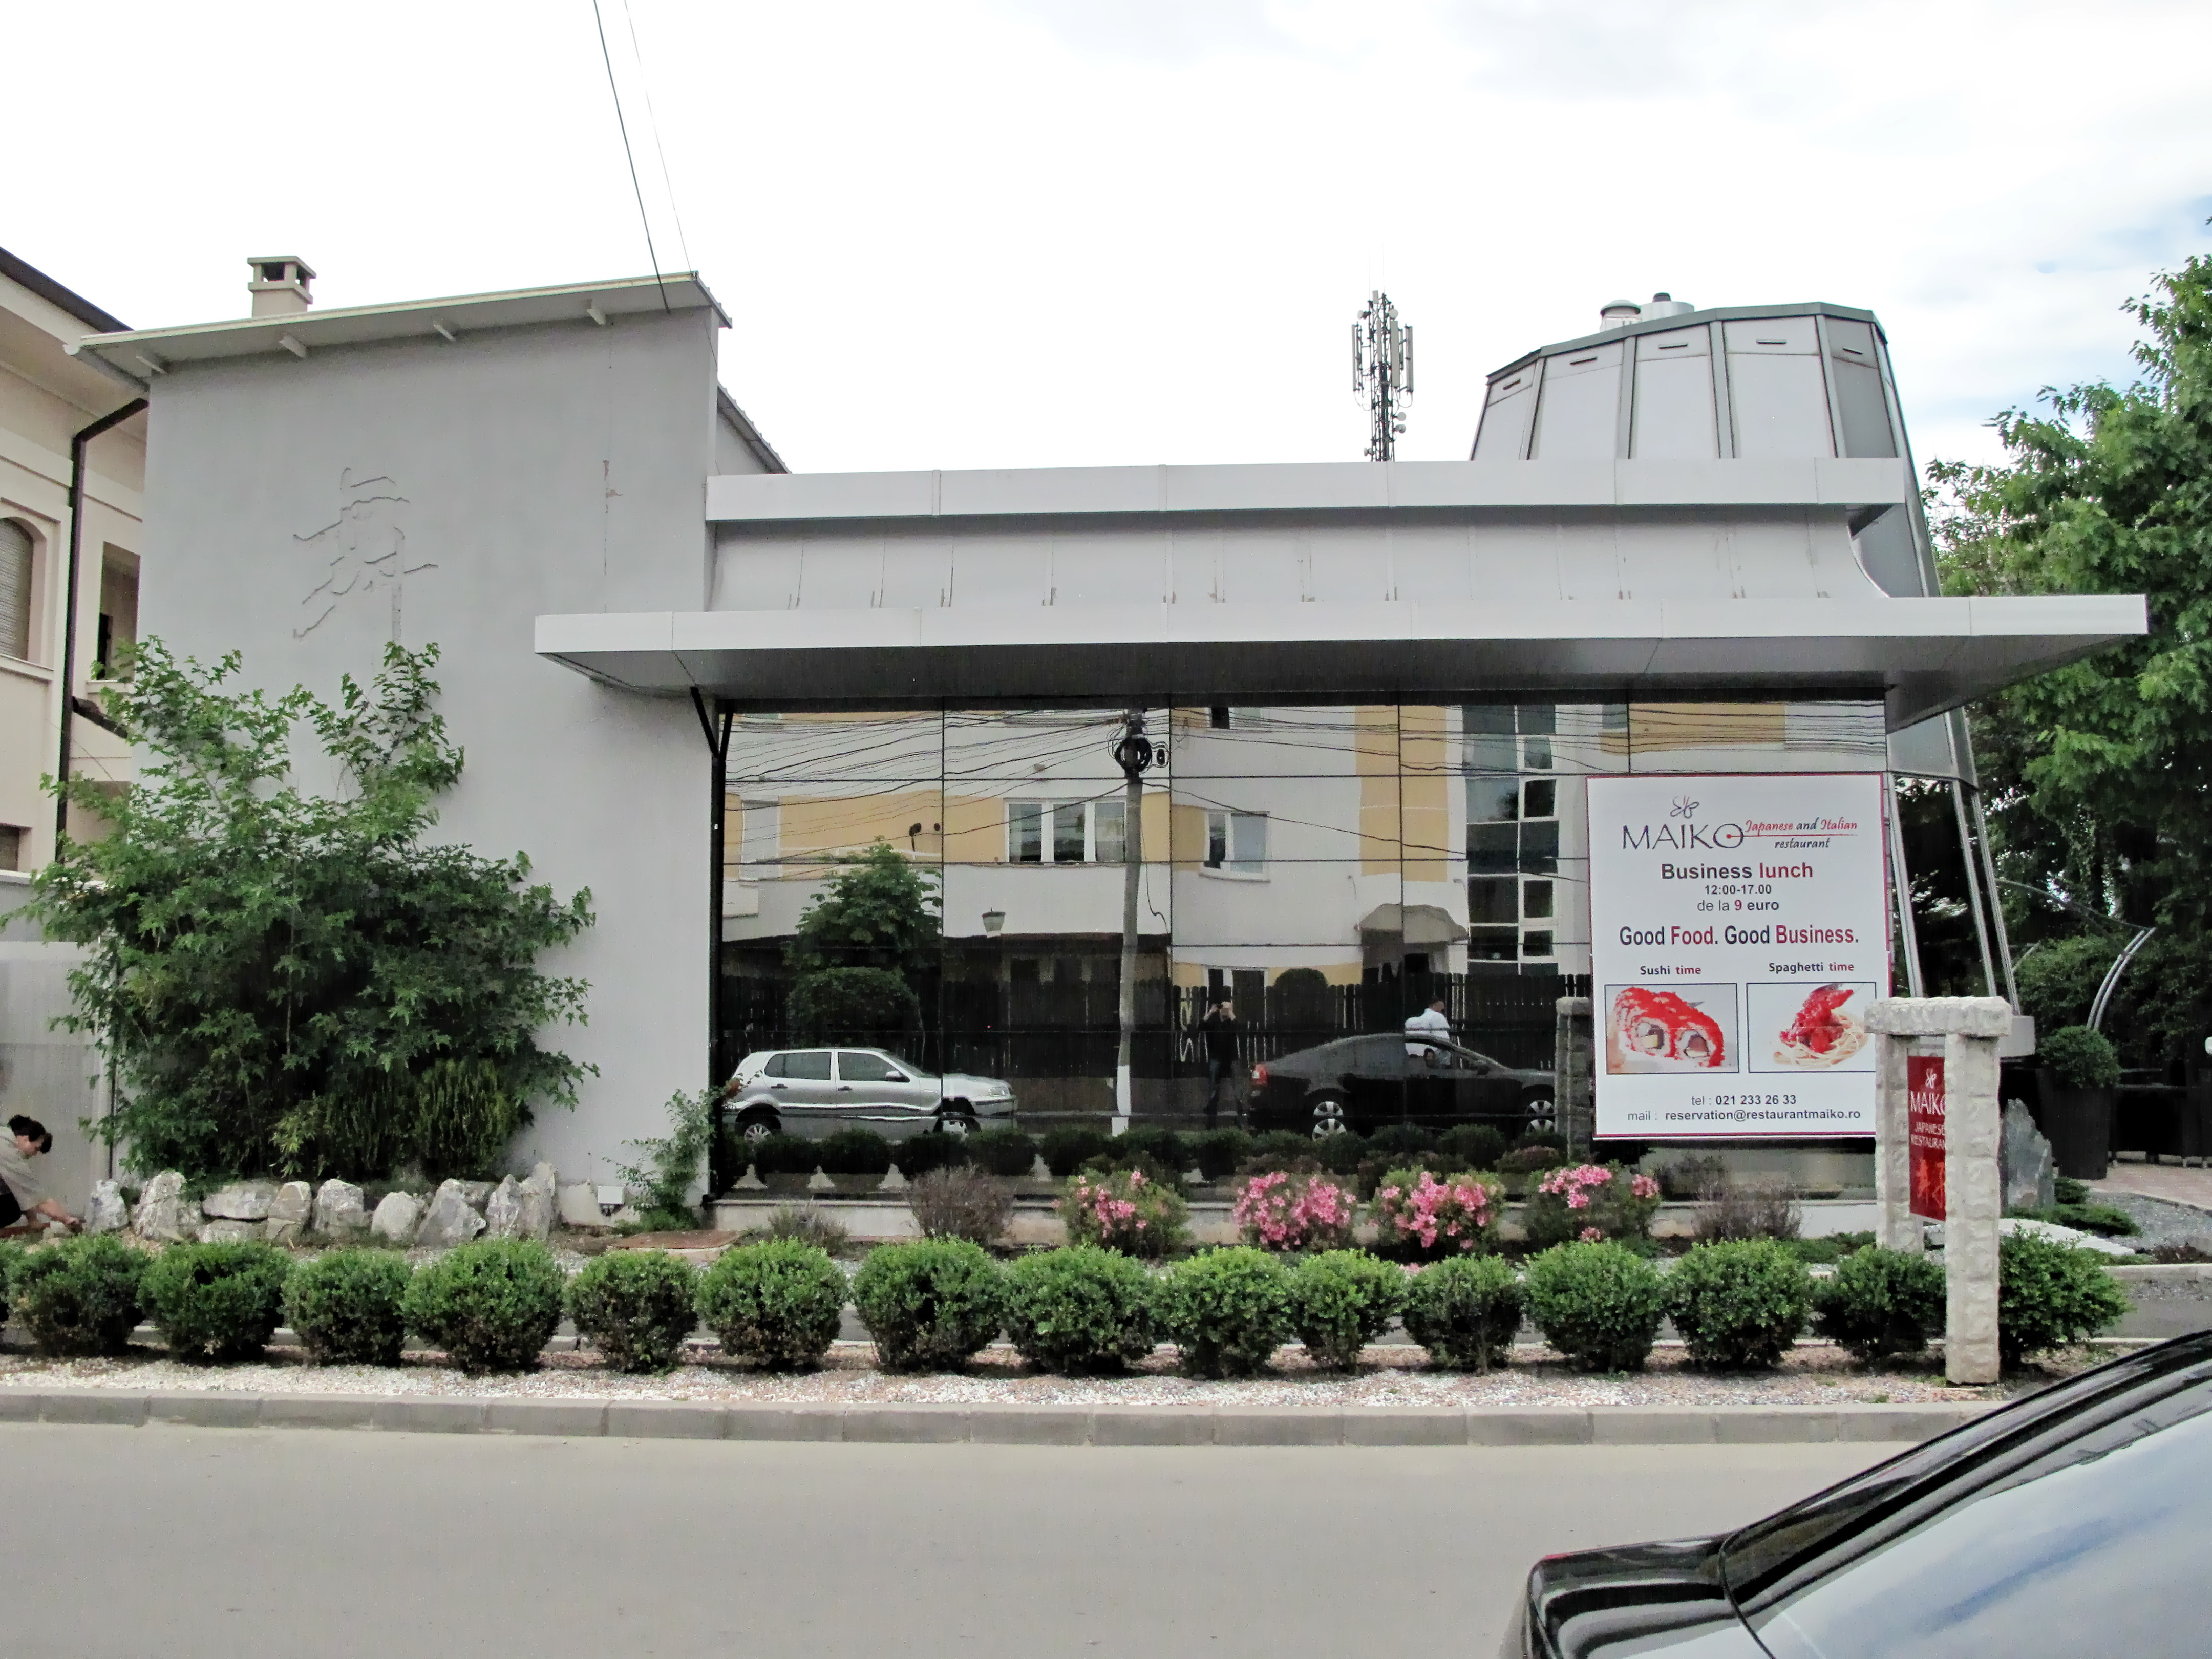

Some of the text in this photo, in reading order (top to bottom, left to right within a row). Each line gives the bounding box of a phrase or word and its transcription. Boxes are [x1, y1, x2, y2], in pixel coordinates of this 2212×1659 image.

[1745, 817, 1858, 836] Japanese and Italian
[1623, 823, 1744, 850] MAIKO
[1774, 838, 1831, 848] restaurant
[1661, 862, 1813, 879] Business lunch
[1705, 884, 1772, 895] 12:00-17.00
[1697, 900, 1779, 911] de la 9 euro
[1620, 925, 1859, 945] Good Food. Good Business.
[1640, 966, 1701, 975] Sushi time
[1769, 962, 1854, 974] Spaghetti time
[1691, 1096, 1705, 1105] tel
[1716, 1095, 1735, 1105] 021
[1741, 1095, 1761, 1104] 233
[1765, 1095, 1779, 1104] 26
[1783, 1095, 1796, 1104] 33
[1628, 1111, 1651, 1120] mail
[1665, 1109, 1860, 1122] reservation@restaurantmaiko.ro
